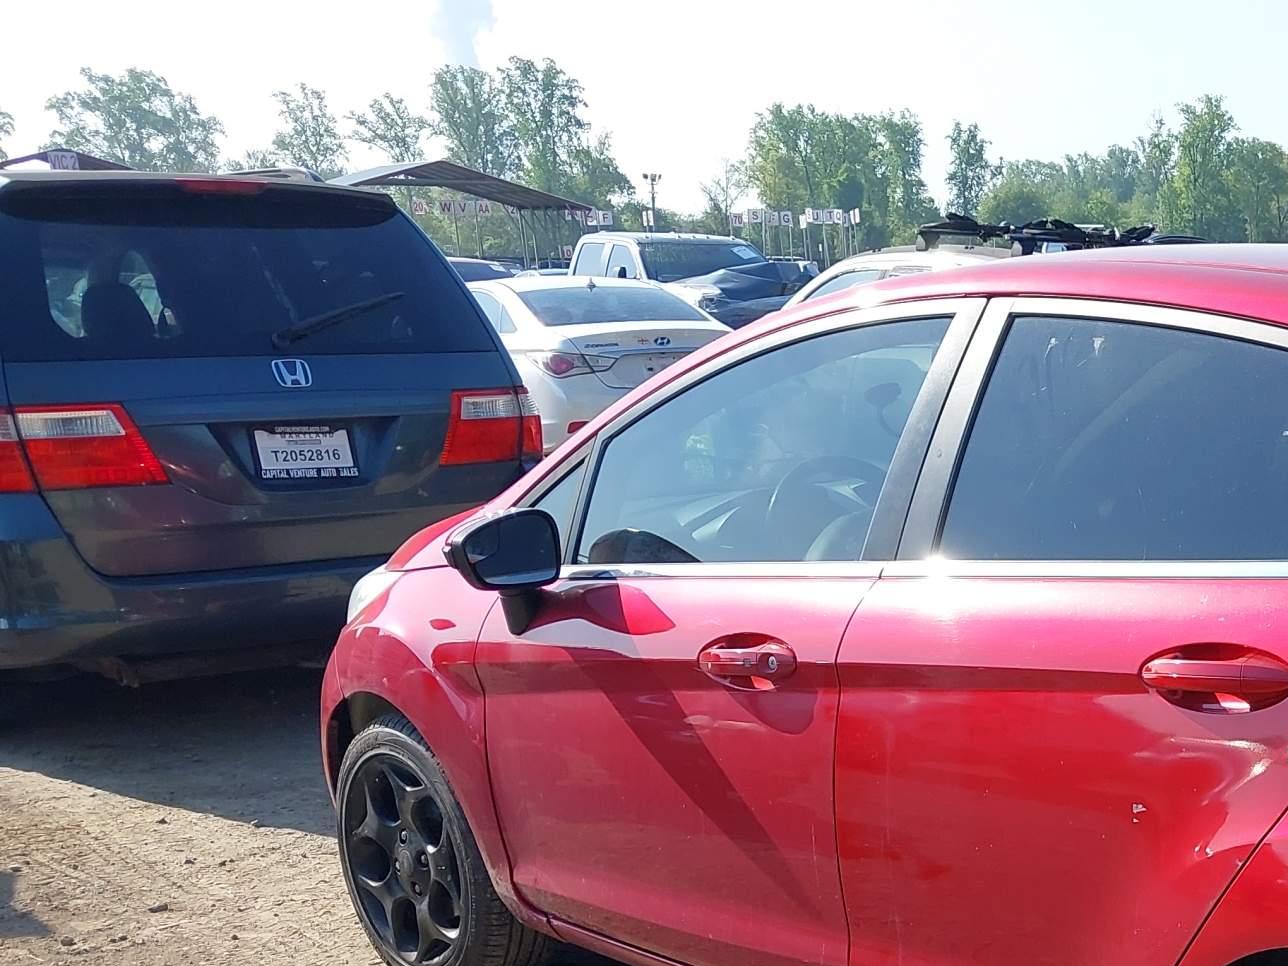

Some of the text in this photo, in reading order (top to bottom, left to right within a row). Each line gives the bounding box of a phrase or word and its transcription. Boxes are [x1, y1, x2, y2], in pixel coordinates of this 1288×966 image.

[270, 448, 342, 463] T2052816
[261, 467, 359, 479] CAPITAL VENTURE AUTO SALES
